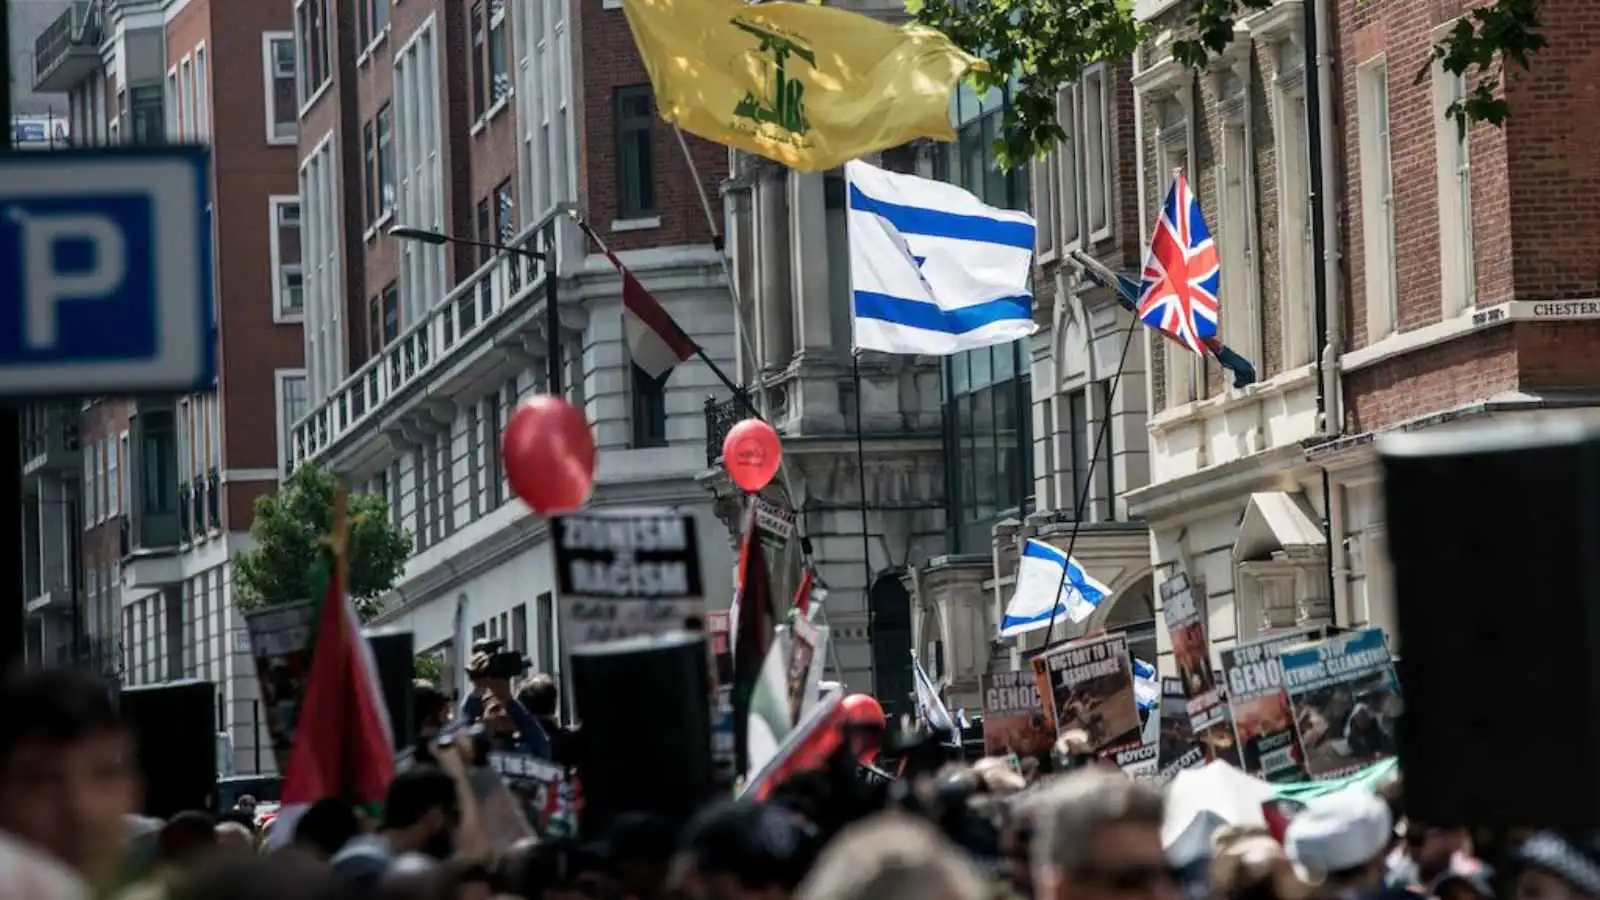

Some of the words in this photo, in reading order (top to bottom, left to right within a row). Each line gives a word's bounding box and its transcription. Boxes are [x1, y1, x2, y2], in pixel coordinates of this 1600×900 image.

[26, 214, 127, 348] P
[1534, 302, 1600, 316] CHESTER
[562, 518, 687, 549] ZIONISM
[570, 559, 689, 596] RACISM
[1050, 647, 1092, 672] VICTORY
[1092, 643, 1106, 660] TO
[1105, 639, 1124, 657] THE
[1233, 645, 1261, 666] STOP
[1320, 638, 1346, 660] STOP
[1062, 657, 1120, 685] RESISTANCE
[1229, 658, 1281, 694] GENO
[1287, 662, 1327, 685] ETHNIC
[1327, 647, 1389, 676] CLEANSING
[987, 686, 1041, 711] GENOC
